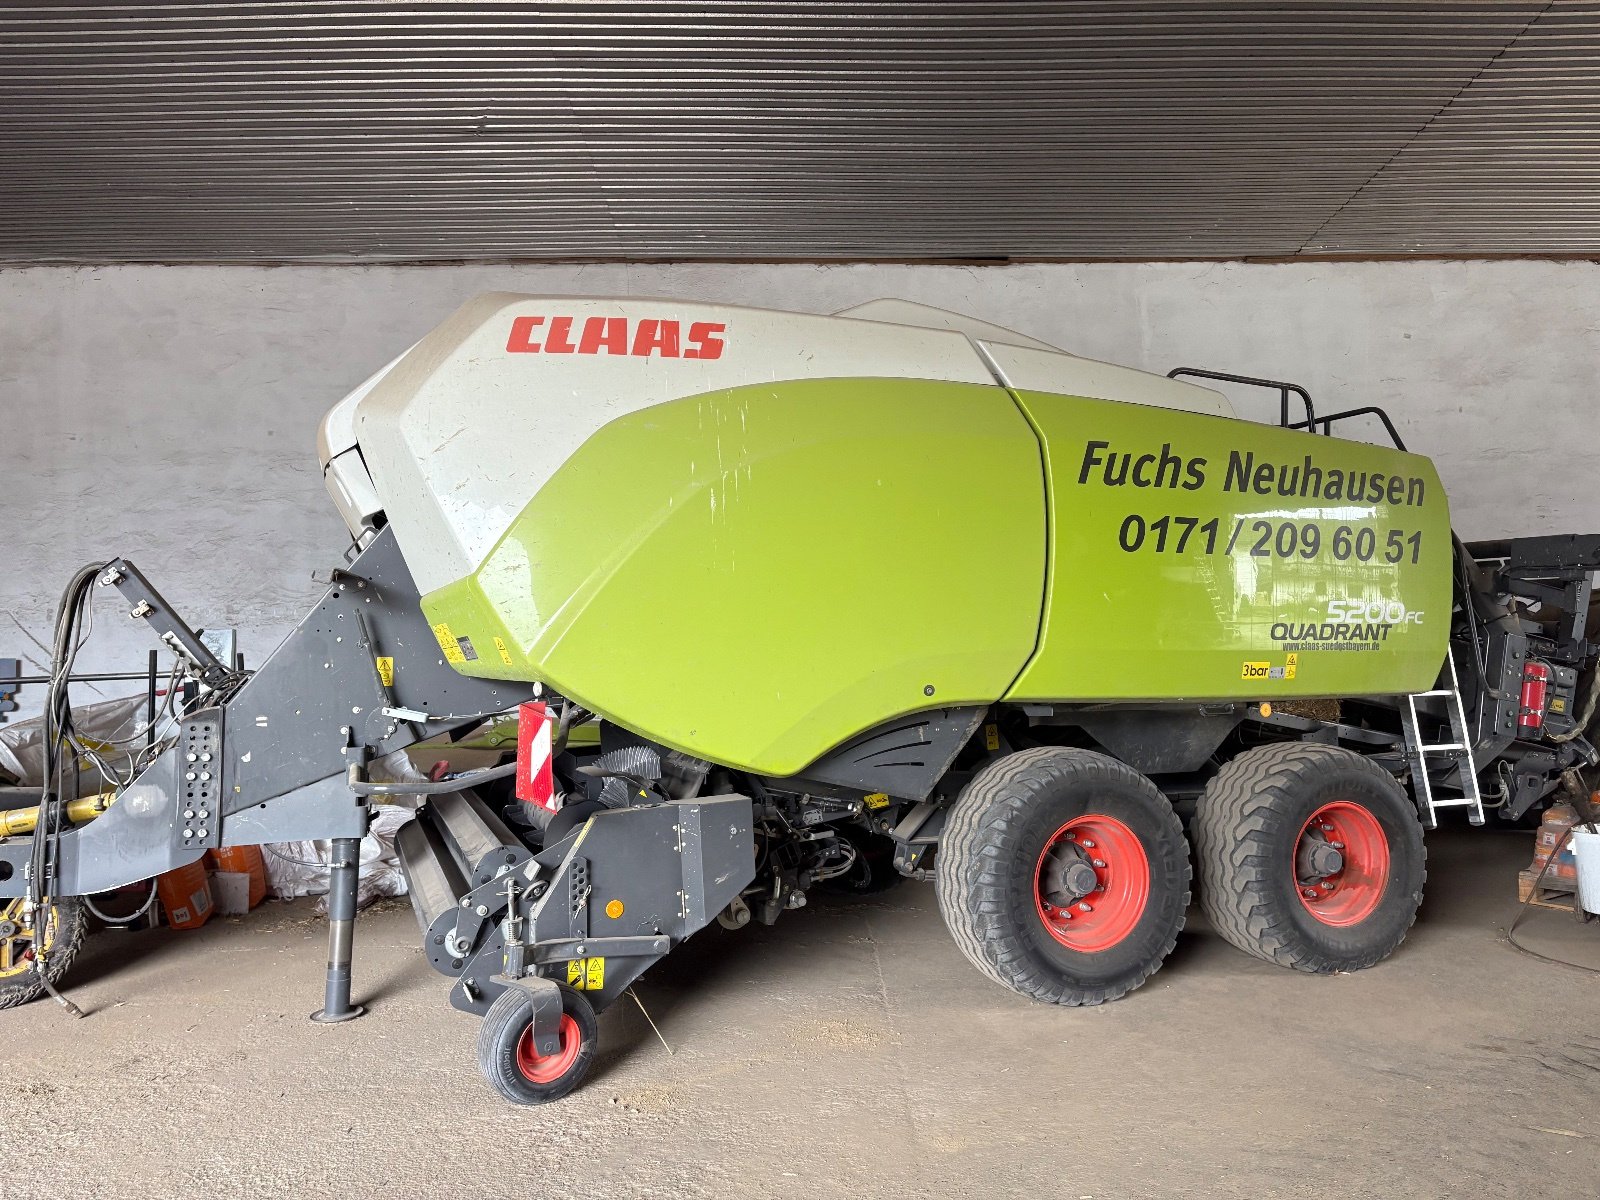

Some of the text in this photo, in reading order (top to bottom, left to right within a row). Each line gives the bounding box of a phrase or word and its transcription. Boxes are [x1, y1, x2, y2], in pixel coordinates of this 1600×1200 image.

[505, 316, 727, 360] CLAAS
[1077, 440, 1425, 507] Fuchs Neuhausen
[1332, 525, 1376, 562] 60
[1384, 529, 1423, 564] 51
[1270, 622, 1393, 641] QUADRANT
[1282, 641, 1380, 652] www.claas-suedostbayern.de
